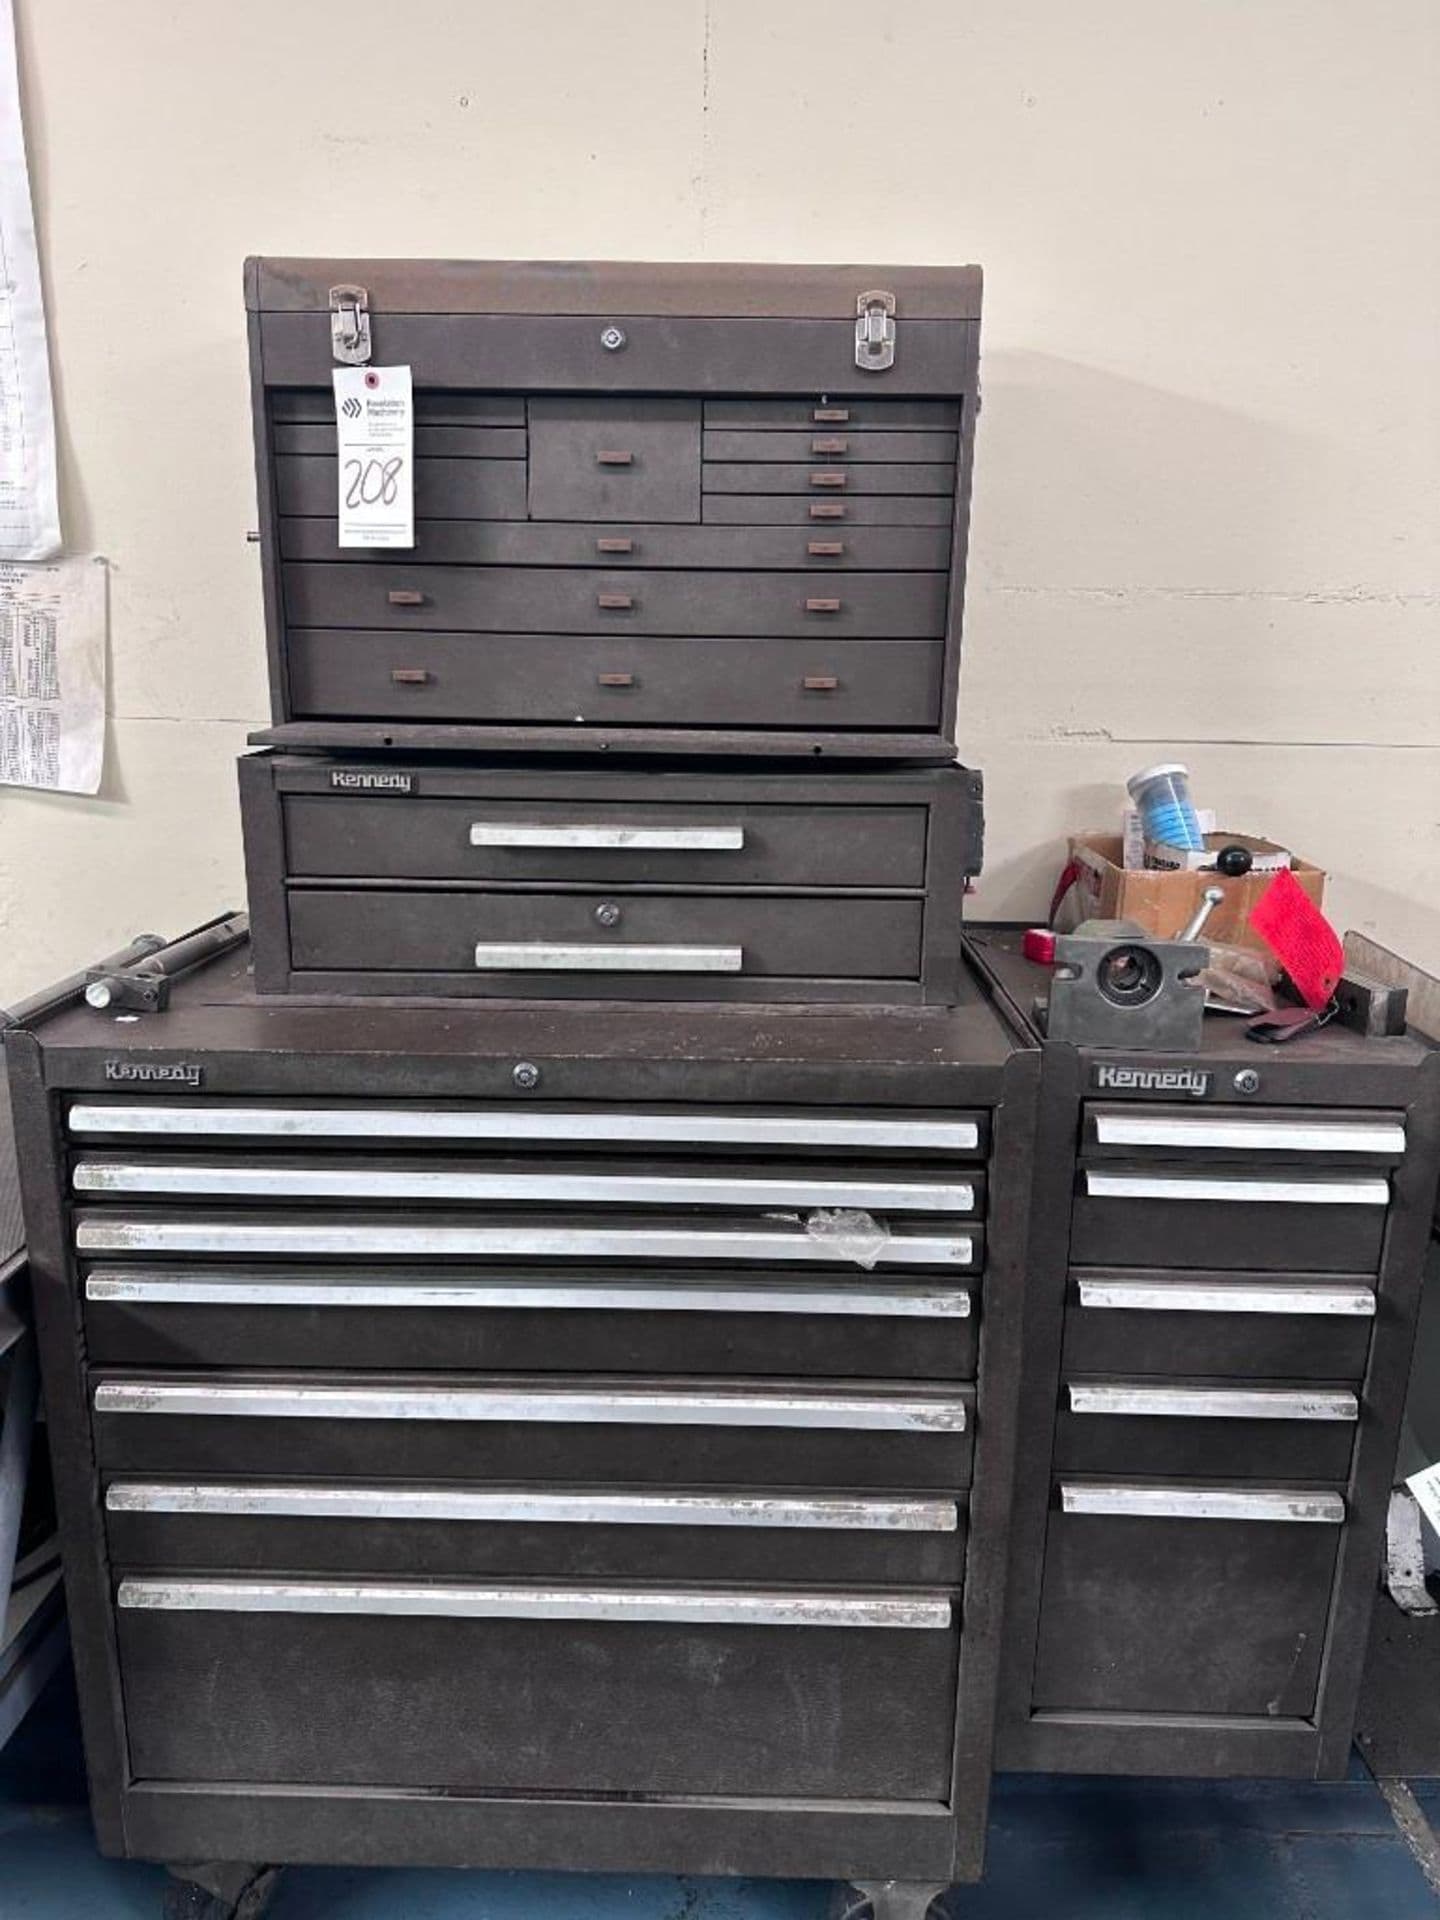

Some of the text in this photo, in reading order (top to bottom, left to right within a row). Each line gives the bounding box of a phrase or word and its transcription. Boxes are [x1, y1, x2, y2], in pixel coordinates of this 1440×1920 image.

[344, 456, 404, 510] 208
[332, 771, 412, 792] Kennedy
[104, 1060, 202, 1086] Kennedy
[1098, 1066, 1208, 1097] Kennedy
